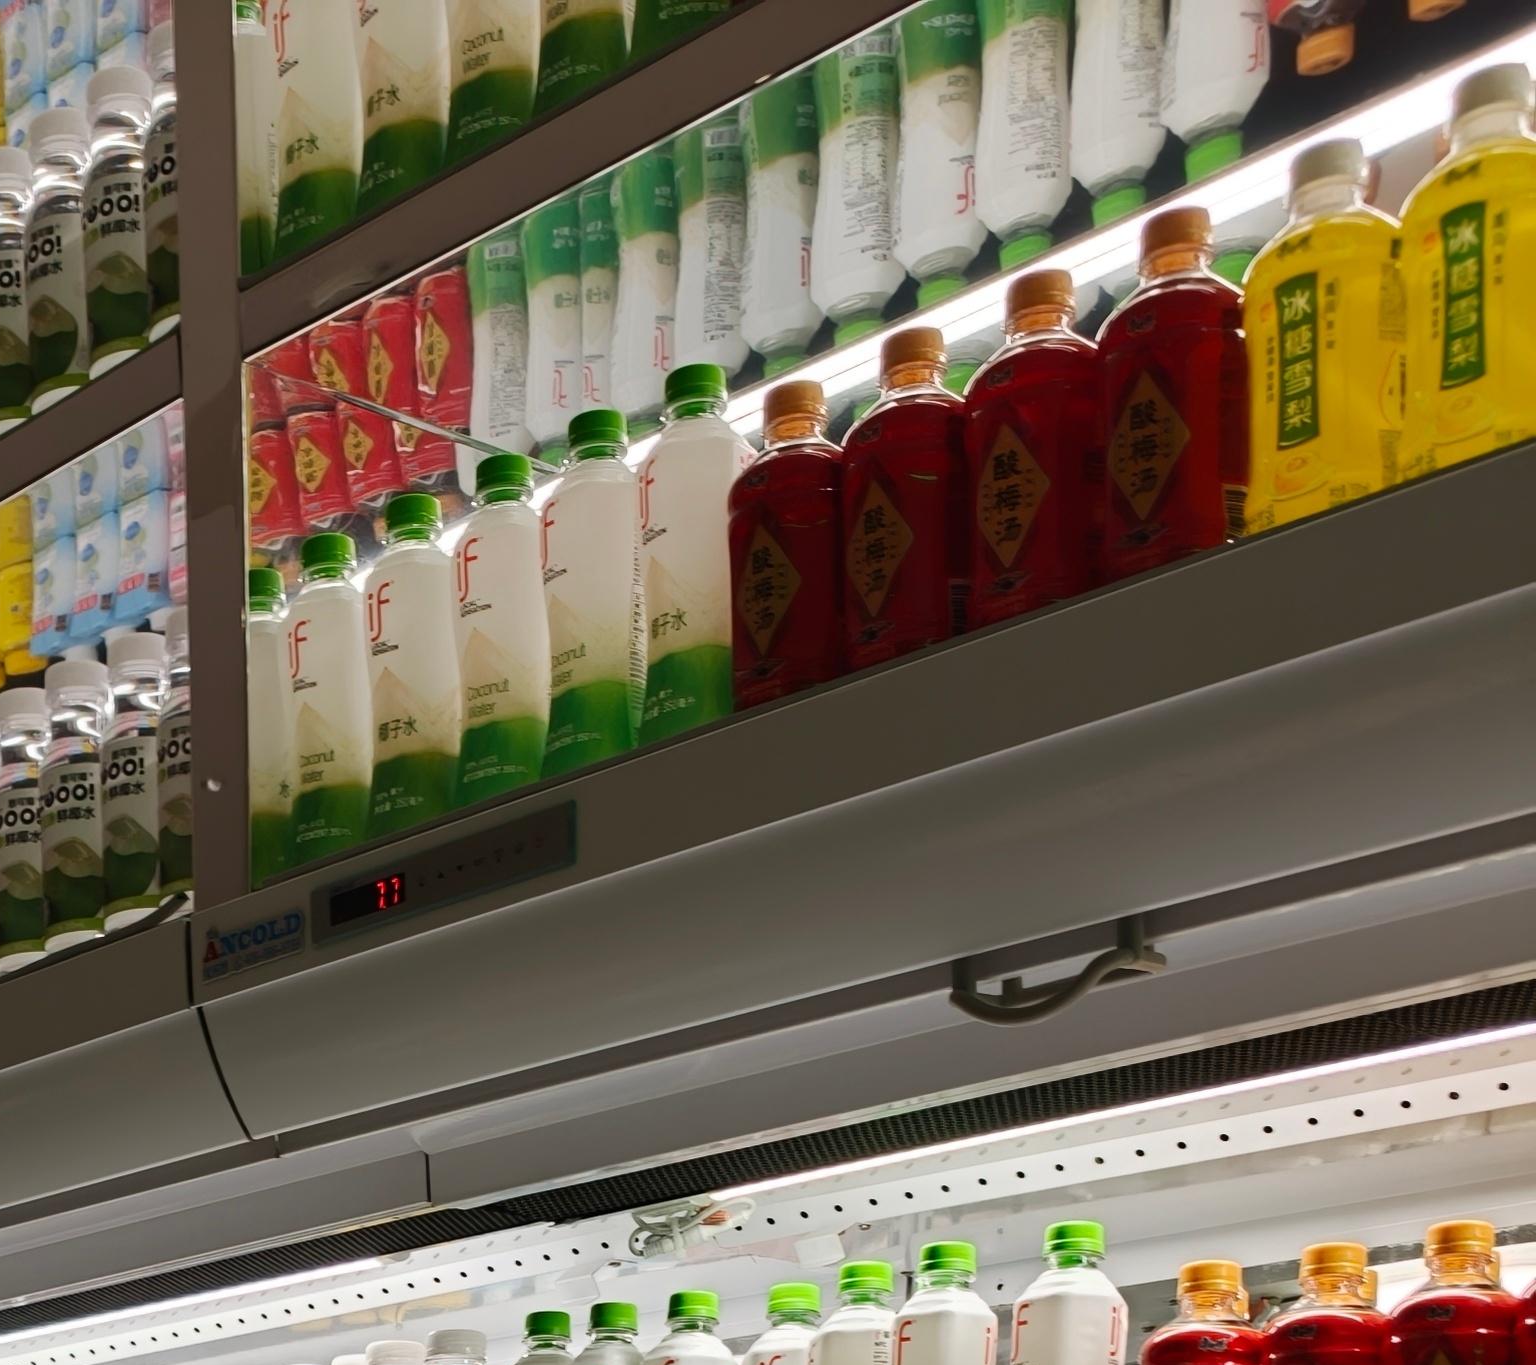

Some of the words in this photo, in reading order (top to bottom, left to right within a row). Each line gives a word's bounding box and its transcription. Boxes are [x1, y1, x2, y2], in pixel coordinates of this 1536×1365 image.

[1447, 211, 1480, 370] 冰糖雪梨
[1281, 287, 1315, 430] 冰糖雪梨
[1127, 398, 1161, 493] 酸梅汤
[991, 453, 1025, 547] 酸梅汤
[457, 537, 479, 603] if
[288, 620, 310, 679] if
[368, 582, 390, 642] if
[204, 912, 302, 963] ANCOLD
